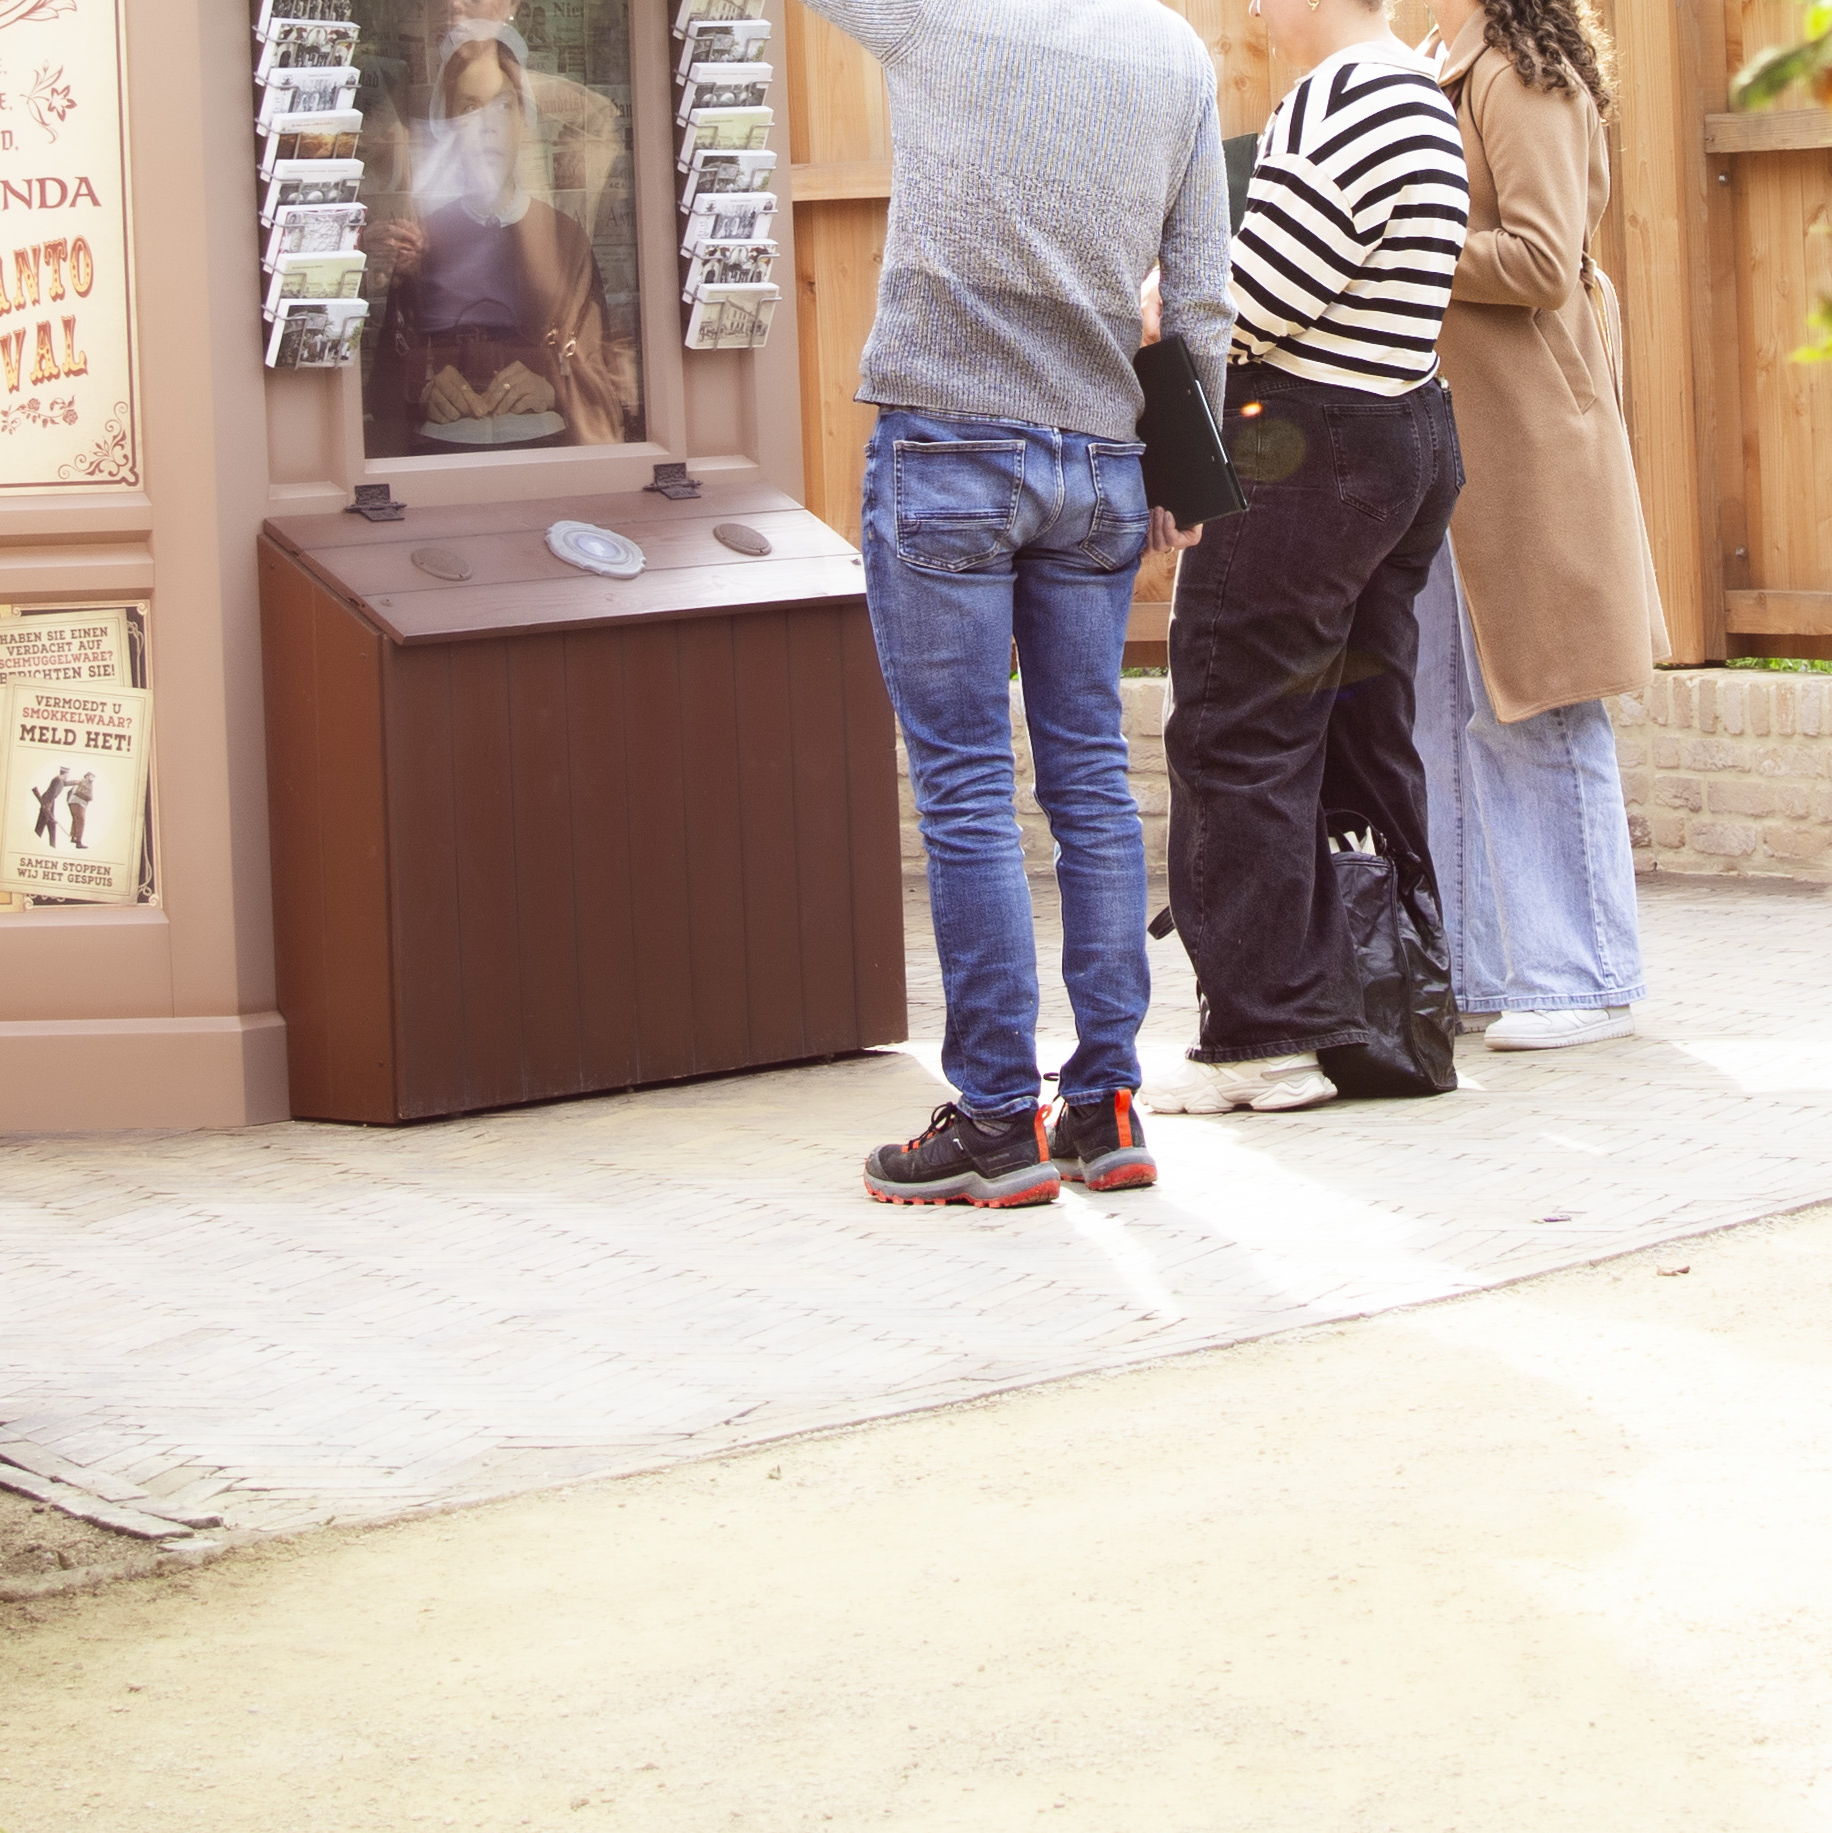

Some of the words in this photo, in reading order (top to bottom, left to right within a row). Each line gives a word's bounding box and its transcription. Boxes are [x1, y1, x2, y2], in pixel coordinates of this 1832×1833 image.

[0, 631, 42, 645] HABEN
[47, 630, 66, 641] SIE
[70, 627, 108, 639] EINEN
[6, 642, 73, 656] VERDACHT
[78, 640, 103, 651] AUF
[88, 664, 115, 678] SIE!
[35, 695, 107, 713] VERMOEDT
[112, 704, 122, 715] U
[22, 707, 133, 729] SMOKKELWAAR?
[19, 724, 77, 746] MELD
[85, 731, 132, 752] HET!
[19, 857, 58, 870] SAMEN
[62, 862, 111, 876] STOPPEN
[17, 868, 38, 879] WIJ
[42, 871, 63, 882] HET
[67, 874, 113, 887] GESPUIS
